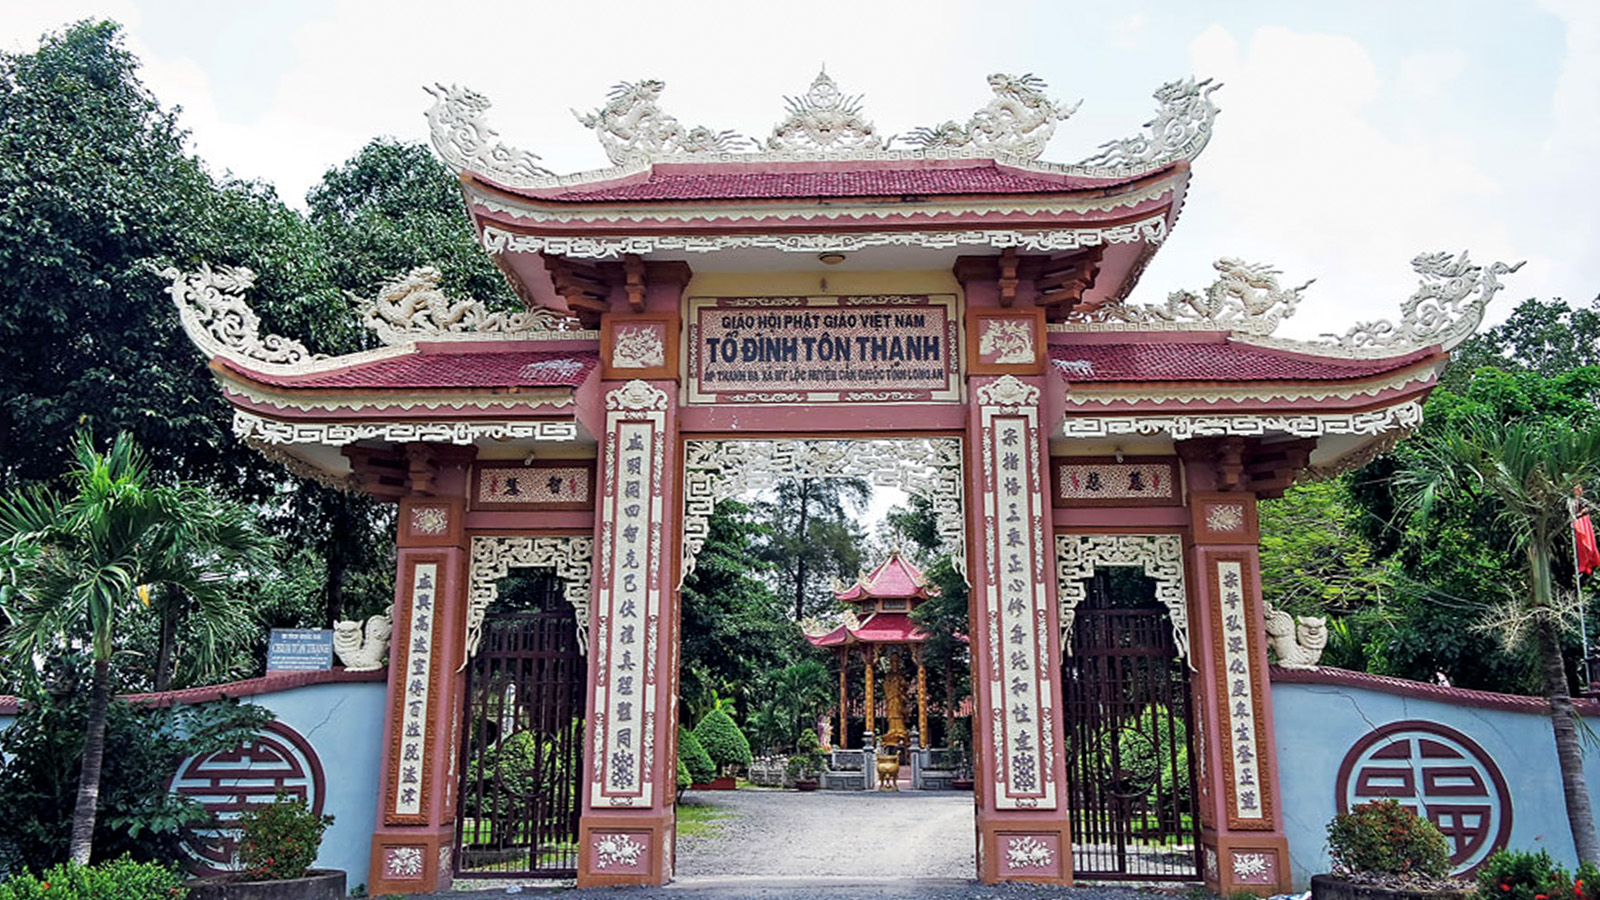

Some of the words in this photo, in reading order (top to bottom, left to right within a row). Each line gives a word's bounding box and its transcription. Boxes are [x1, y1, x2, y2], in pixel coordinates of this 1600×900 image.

[722, 313, 754, 329] GIÁO
[758, 312, 781, 333] HỘI
[784, 312, 820, 331] PHẬT
[824, 311, 856, 328] GIÁO
[860, 311, 891, 331] VIỆT
[895, 314, 925, 328] NAM
[706, 330, 739, 363] TỔ
[742, 332, 797, 362] ĐÌNH
[801, 331, 851, 361] TÔN
[855, 335, 939, 366] THẠNH
[789, 366, 807, 383] LỘC
[932, 369, 944, 380] AN
